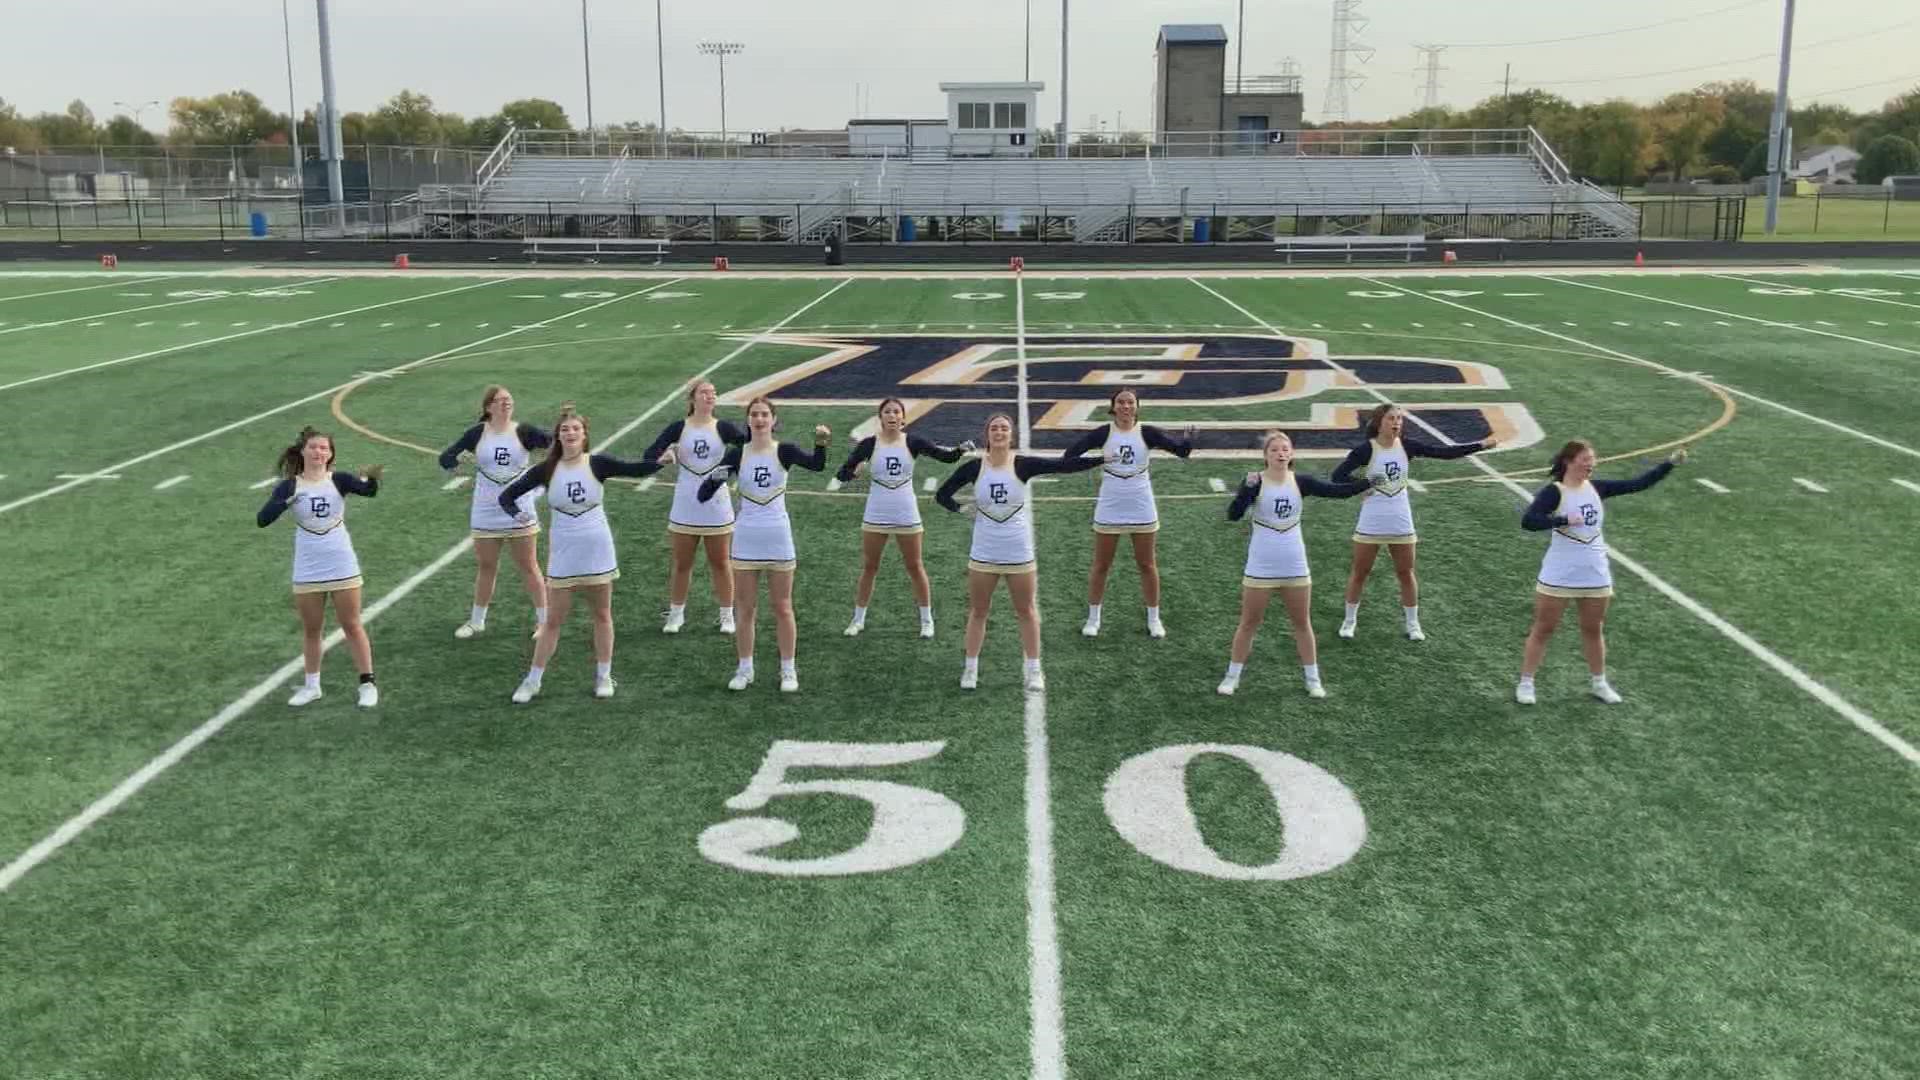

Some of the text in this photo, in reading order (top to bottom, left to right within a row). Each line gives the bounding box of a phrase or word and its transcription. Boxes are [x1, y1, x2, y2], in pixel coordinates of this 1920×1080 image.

[495, 447, 511, 466] DC
[693, 439, 709, 459] DC
[886, 456, 902, 476] DC
[754, 466, 772, 488] DC
[565, 481, 586, 504] DC
[989, 483, 1009, 504] DC
[310, 497, 330, 518] DC
[1274, 498, 1292, 519] DC
[697, 740, 1367, 880] 50
